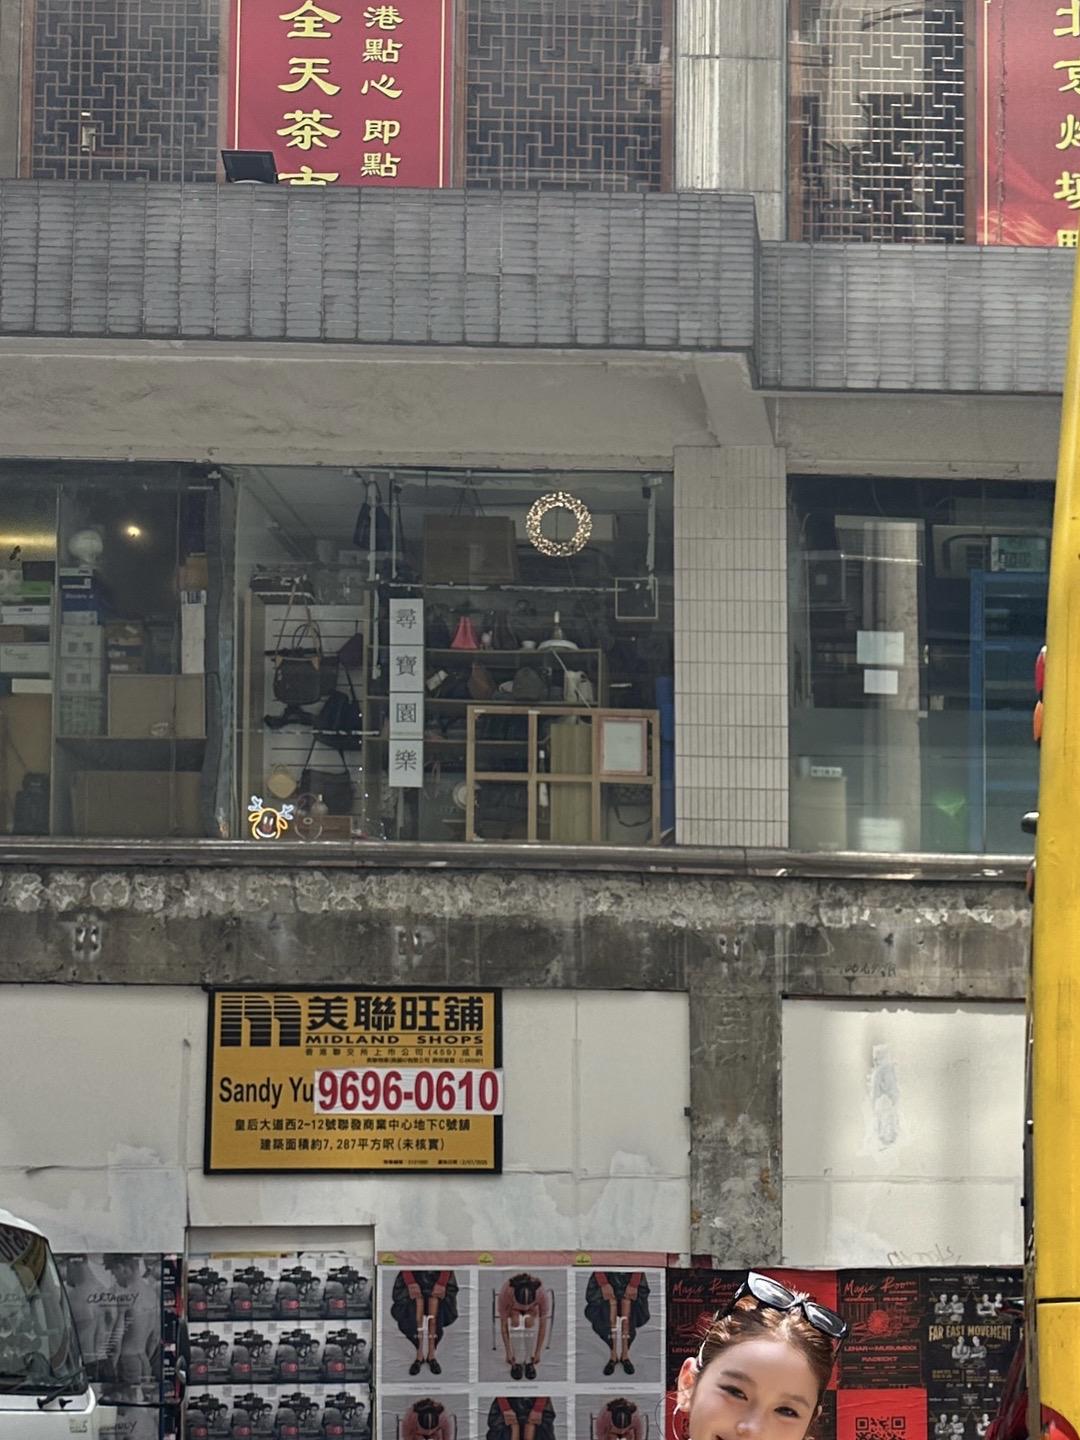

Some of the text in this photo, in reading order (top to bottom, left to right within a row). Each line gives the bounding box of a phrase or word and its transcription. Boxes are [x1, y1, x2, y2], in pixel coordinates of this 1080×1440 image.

[306, 995, 484, 1032] 美聯旺舖
[305, 1035, 484, 1045] MIDLAND SHOPS
[218, 1070, 499, 1112] Sandy Yu 9696-0610
[928, 1325, 944, 1342] FAR
[945, 1325, 966, 1338] EAST
[967, 1325, 1012, 1341] MOVEMENT
